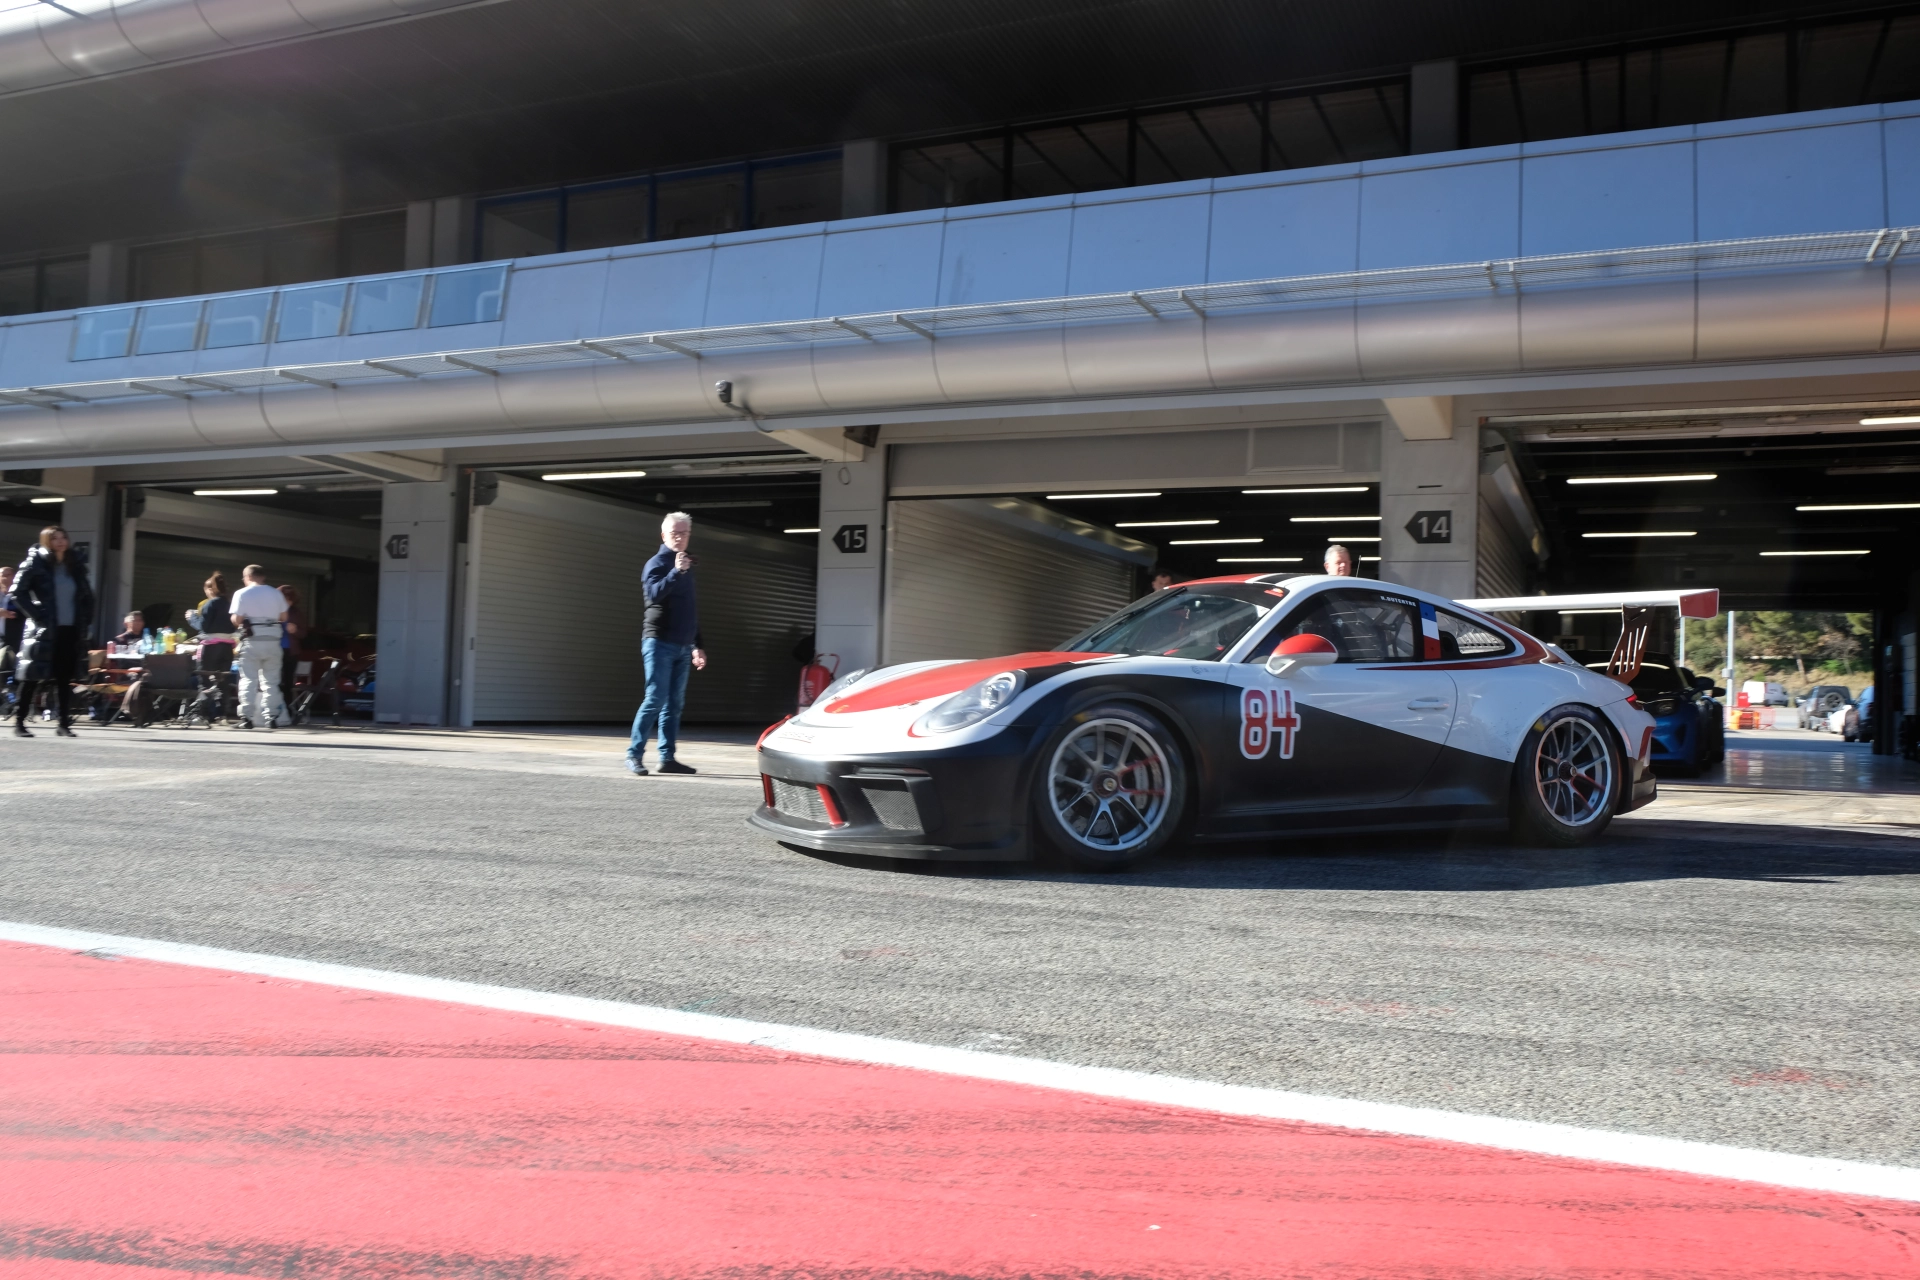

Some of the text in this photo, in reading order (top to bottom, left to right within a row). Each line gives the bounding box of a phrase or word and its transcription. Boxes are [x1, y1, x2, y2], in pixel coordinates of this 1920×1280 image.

[1417, 516, 1450, 538] 14
[390, 538, 409, 555] 16
[841, 529, 866, 549] 15
[1240, 686, 1301, 760] 84
